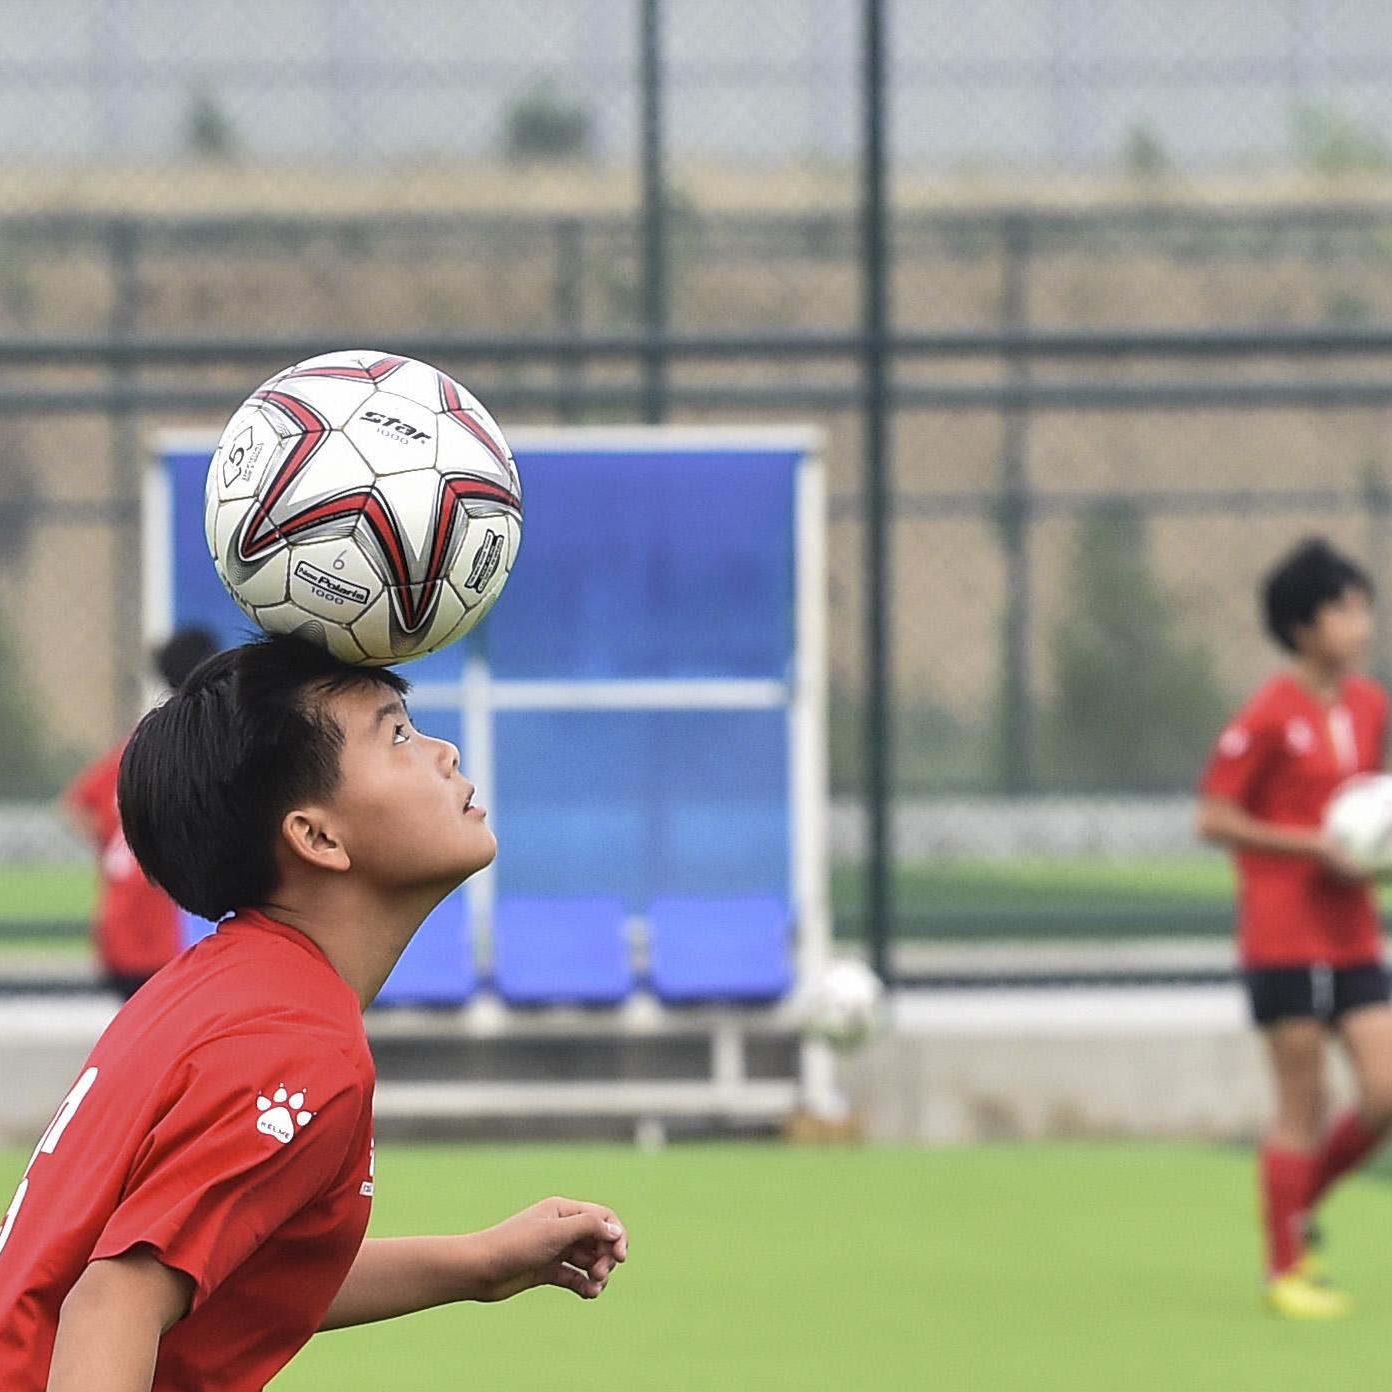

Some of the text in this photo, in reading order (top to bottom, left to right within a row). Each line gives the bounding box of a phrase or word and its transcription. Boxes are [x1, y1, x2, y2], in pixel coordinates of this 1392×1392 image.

[376, 427, 409, 445] 1000
[228, 443, 245, 467] 5
[332, 549, 348, 570] 6
[311, 586, 345, 605] 1000
[317, 576, 365, 600] Polaris
